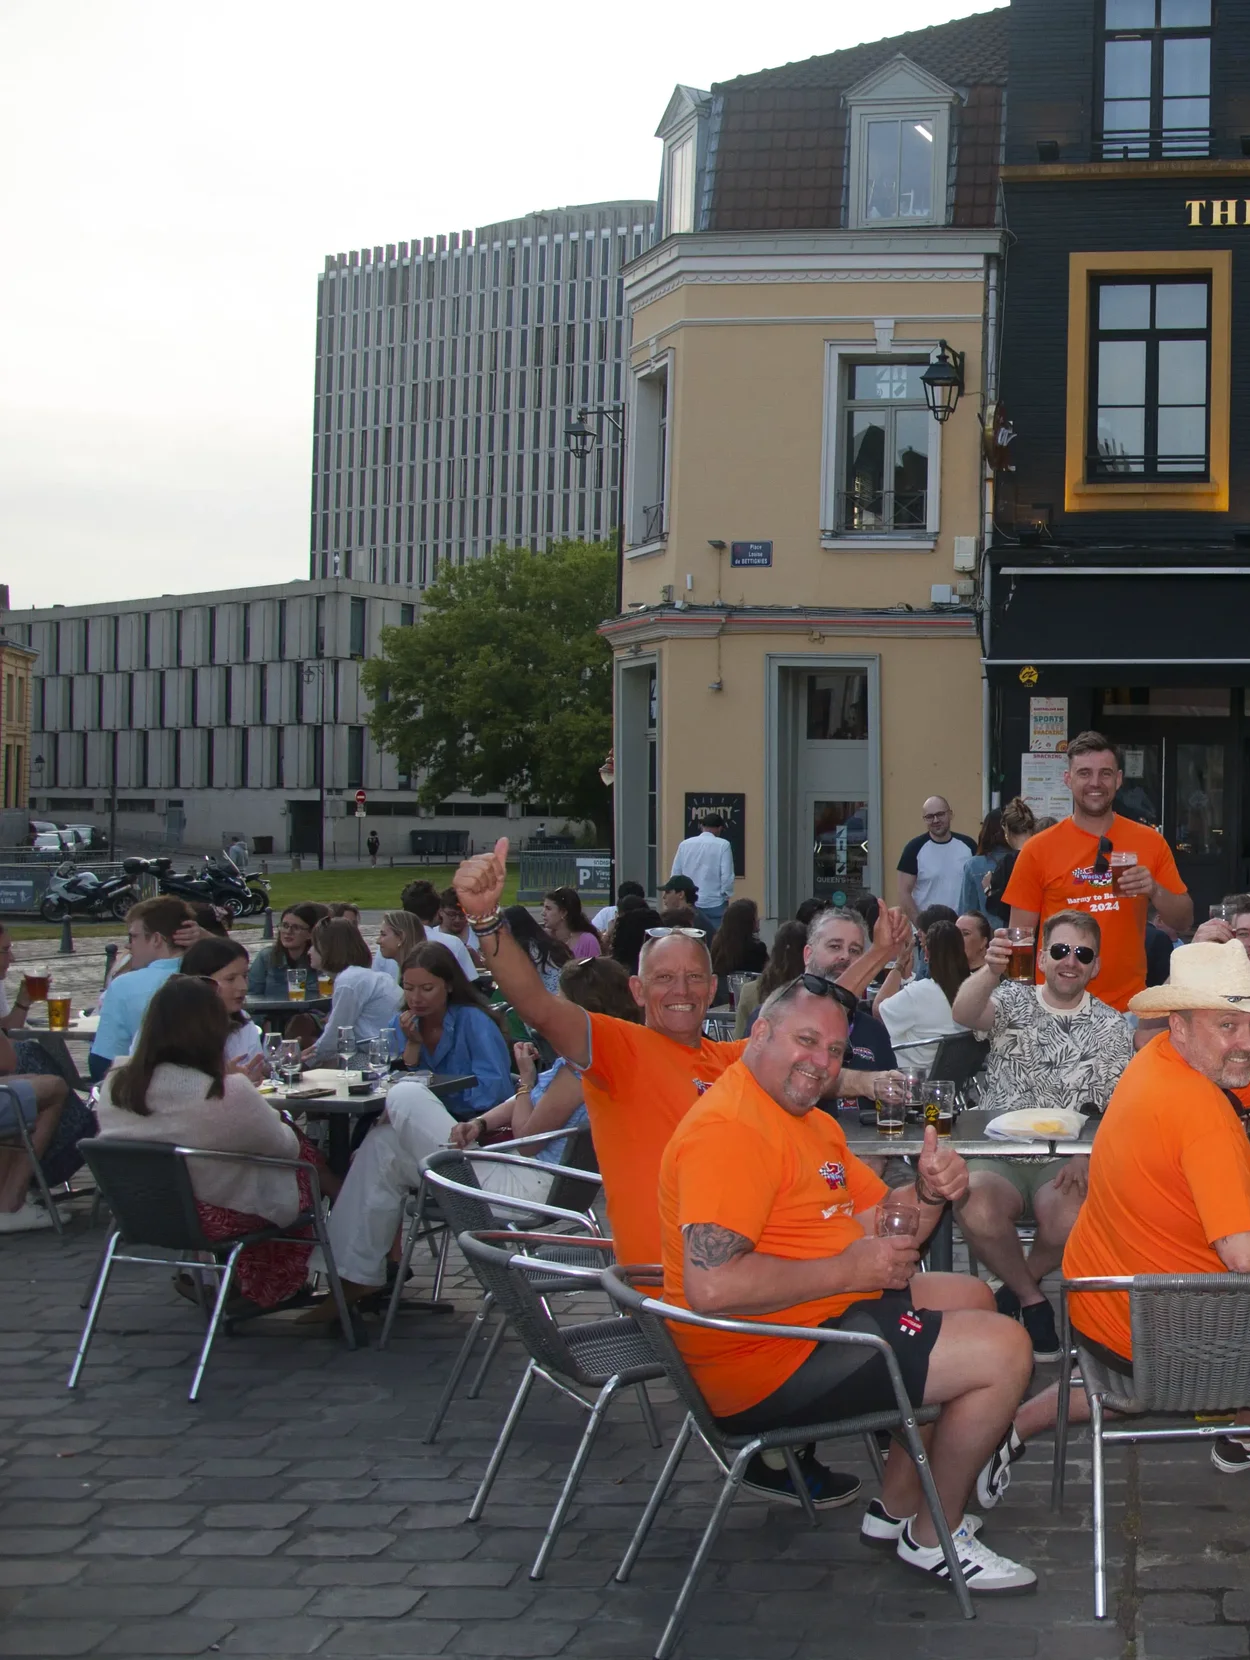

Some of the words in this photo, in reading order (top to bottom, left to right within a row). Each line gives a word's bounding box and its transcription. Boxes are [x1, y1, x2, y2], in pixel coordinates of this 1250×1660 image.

[1033, 715, 1064, 723] SPORTS
[580, 869, 591, 885] P
[1090, 901, 1119, 912] 2024
